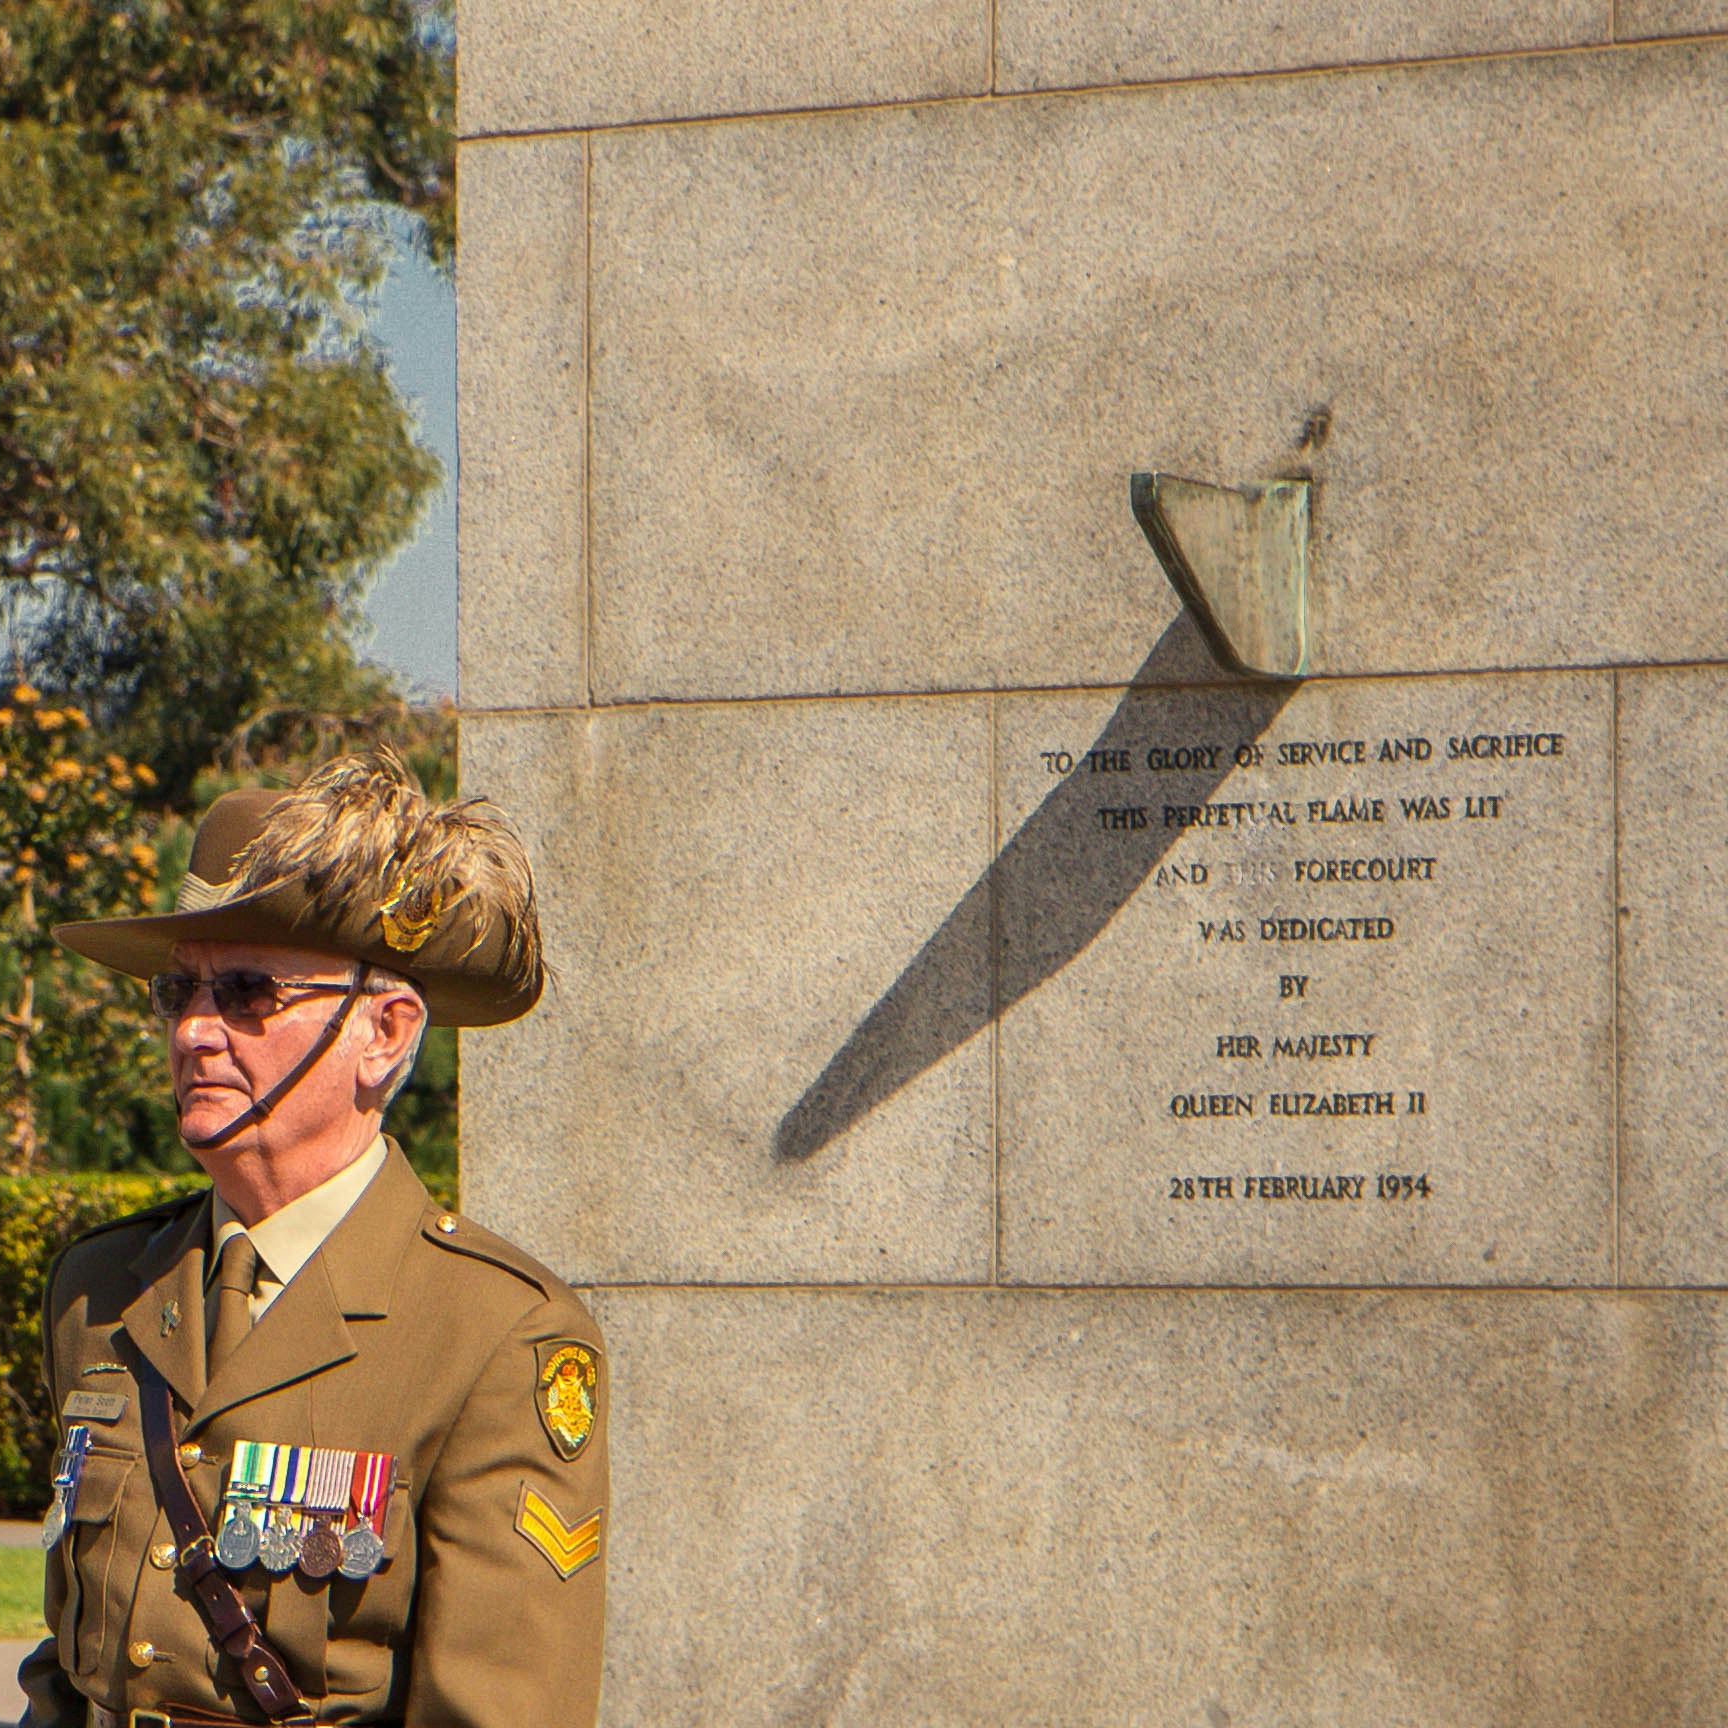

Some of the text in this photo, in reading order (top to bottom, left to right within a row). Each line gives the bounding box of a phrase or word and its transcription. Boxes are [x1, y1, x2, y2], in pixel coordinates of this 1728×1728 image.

[1041, 732, 1564, 774] TO THE GLORY OF SERVICE AND SACRIFICE
[1097, 795, 1504, 830] THIS PERPETUAL FLAME WAS LIT
[1156, 863, 1209, 887] AND
[1294, 857, 1437, 882] FORECOURT
[1260, 917, 1394, 941] DEDICATED
[1279, 975, 1310, 999] BY
[1216, 1033, 1376, 1059] HER MAJESTY
[1170, 1091, 1427, 1118] QUEEN ELIZABETH II
[1169, 1174, 1432, 1200] 28TH FEBRUARY 1954
